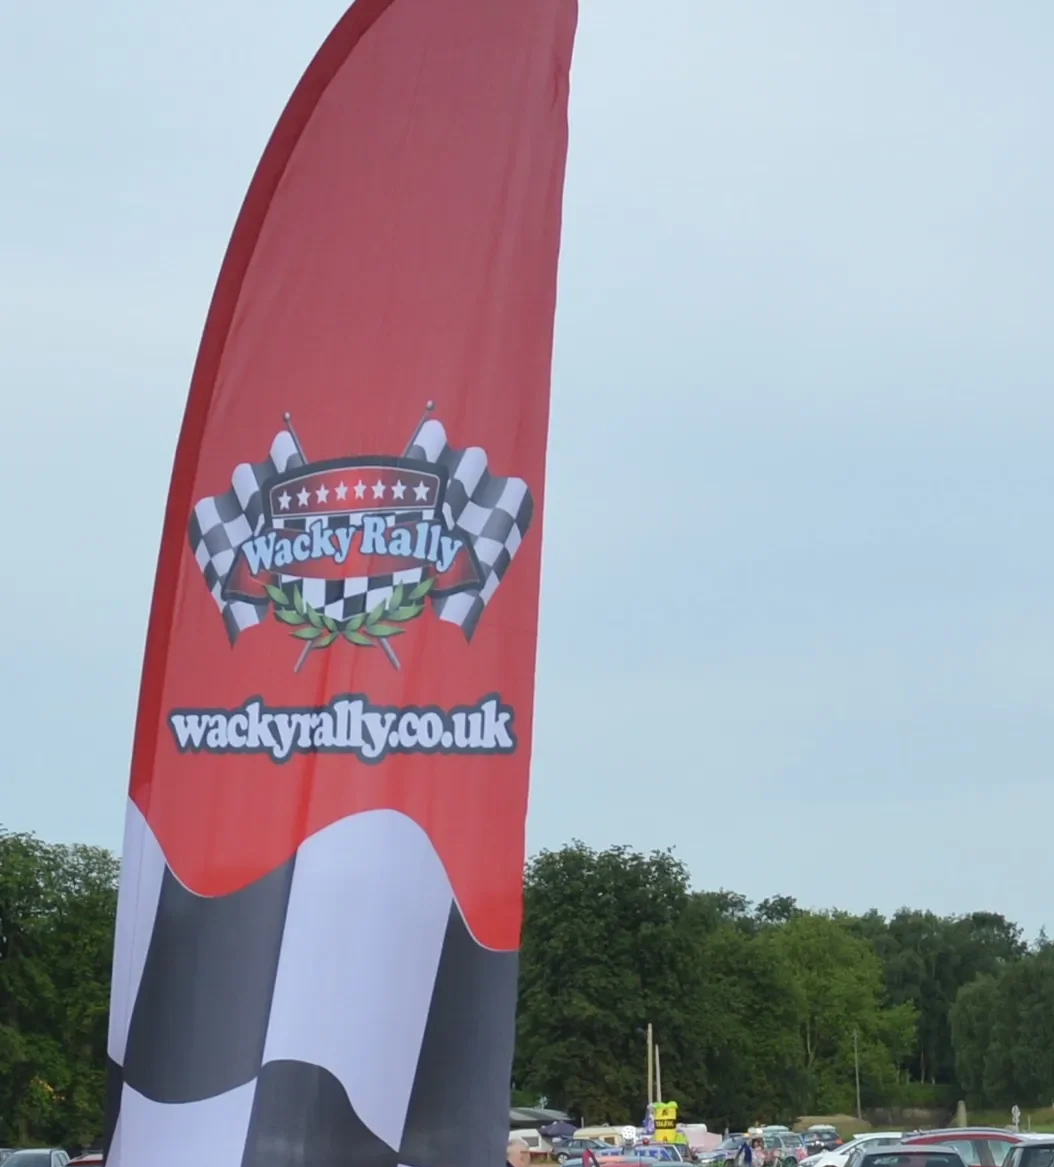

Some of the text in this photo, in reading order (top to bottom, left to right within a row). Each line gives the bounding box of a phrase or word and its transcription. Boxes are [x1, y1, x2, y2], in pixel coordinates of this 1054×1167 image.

[241, 516, 463, 575] Wacky Rally
[169, 698, 513, 758] wackyrally.co.uk
